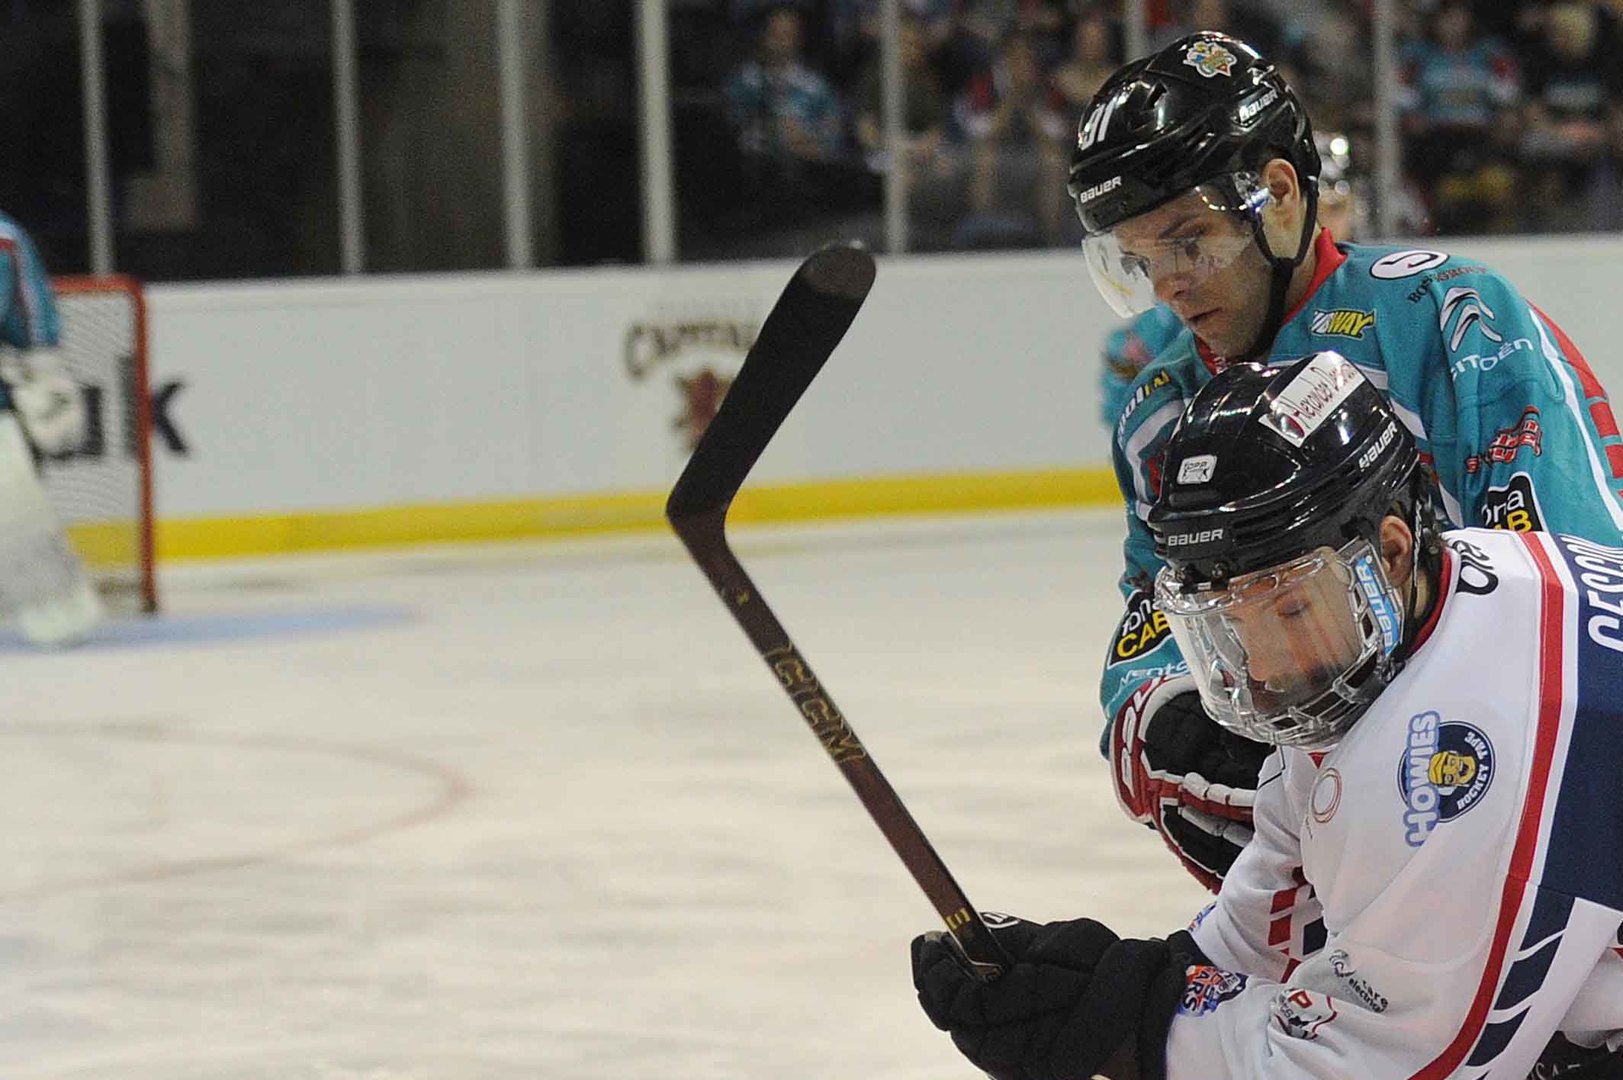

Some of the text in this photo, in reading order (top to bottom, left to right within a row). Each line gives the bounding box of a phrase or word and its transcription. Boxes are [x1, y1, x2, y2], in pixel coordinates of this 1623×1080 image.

[1080, 175, 1122, 204] BAUER
[1167, 528, 1223, 547] BAUER
[1403, 710, 1441, 848] HOWIES
